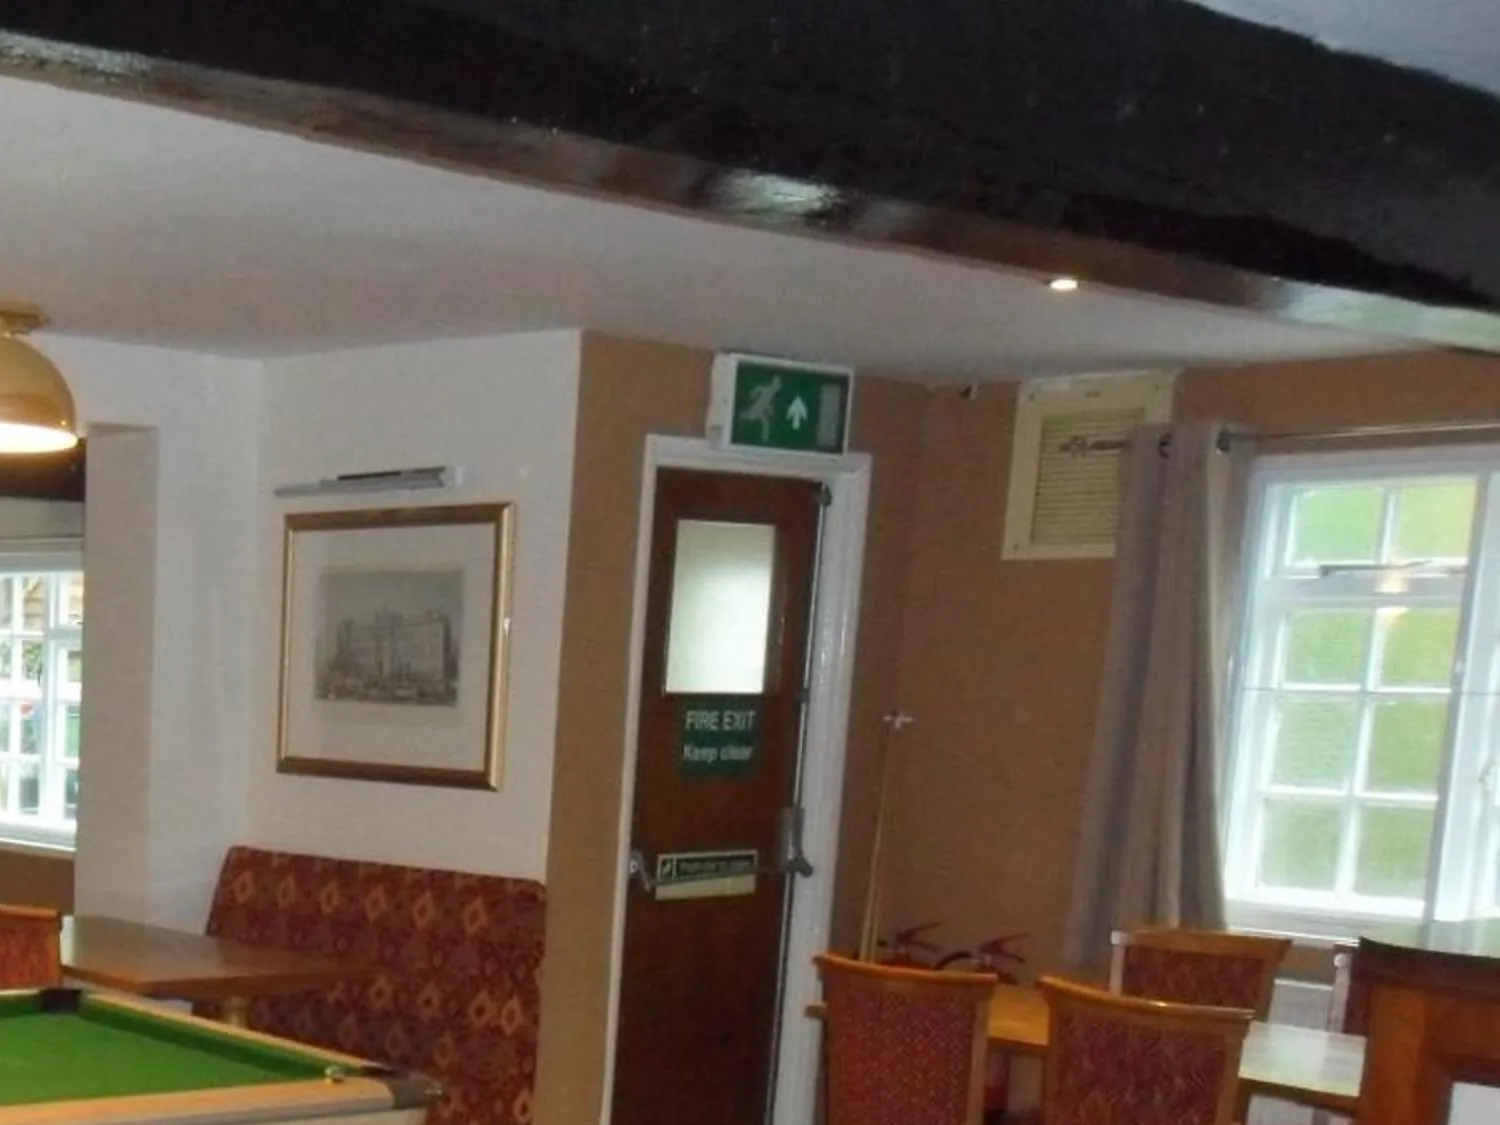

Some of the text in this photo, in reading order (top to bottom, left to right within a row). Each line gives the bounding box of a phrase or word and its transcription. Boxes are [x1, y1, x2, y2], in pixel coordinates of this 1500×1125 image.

[685, 710, 756, 731] FIRE EXIT
[683, 745, 718, 763] Keep
